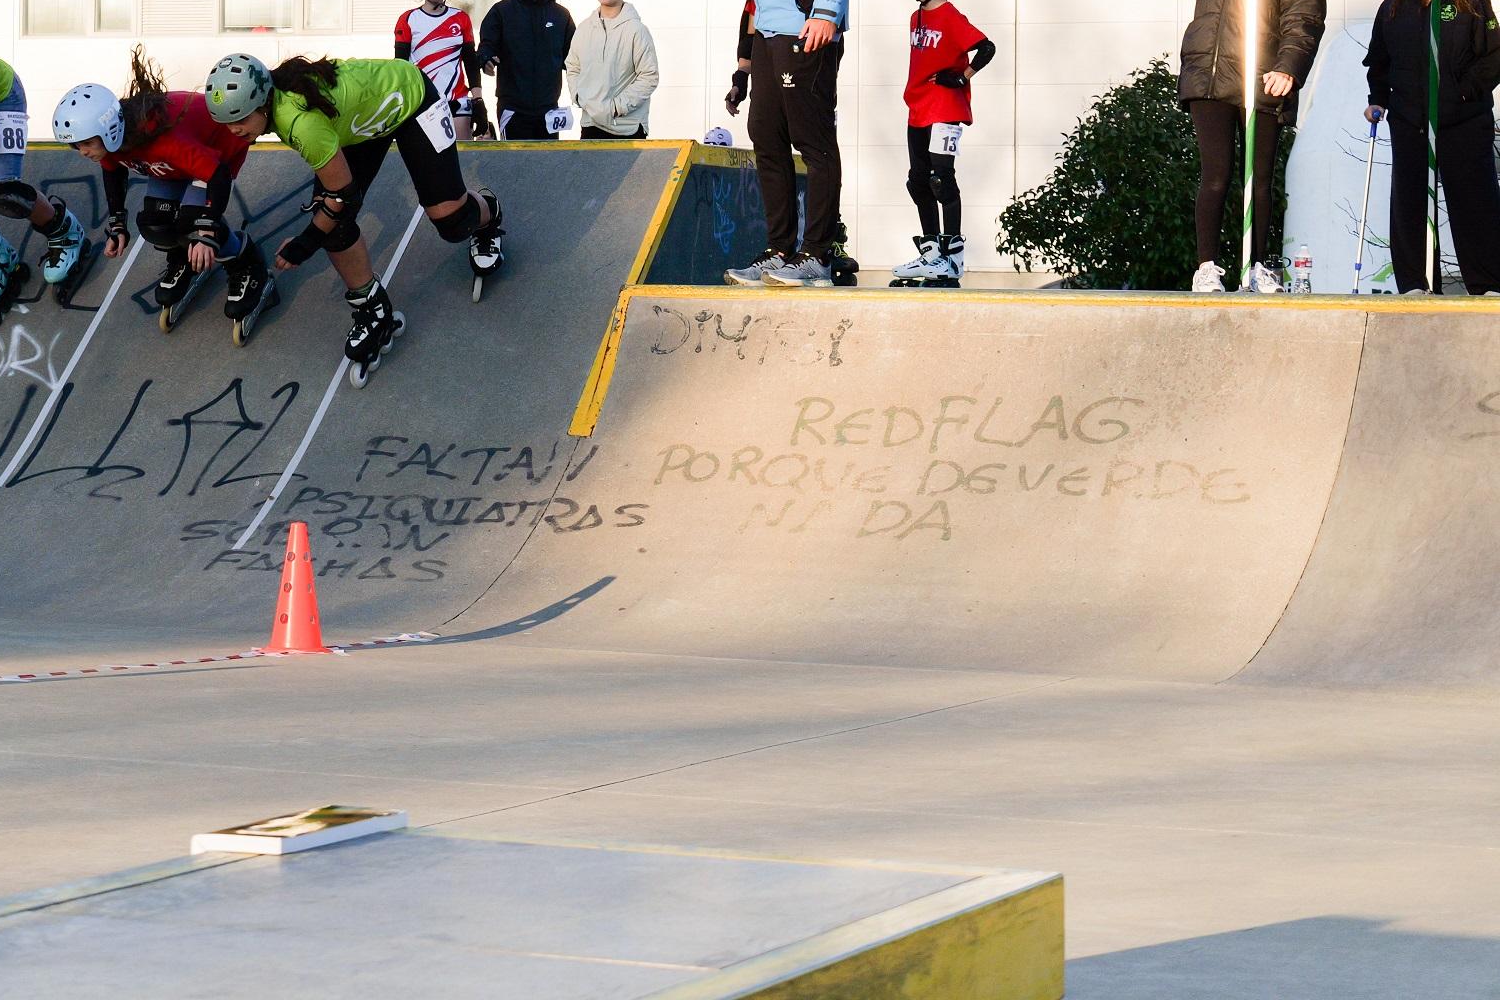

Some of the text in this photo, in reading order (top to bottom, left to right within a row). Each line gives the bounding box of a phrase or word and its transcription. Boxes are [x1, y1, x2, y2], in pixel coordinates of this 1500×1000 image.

[553, 116, 567, 130] 84
[2, 127, 25, 150] 88
[942, 135, 957, 152] 13
[355, 435, 600, 486] FALTAN
[653, 443, 893, 495] PORQUE
[203, 549, 449, 583] FAHAS
